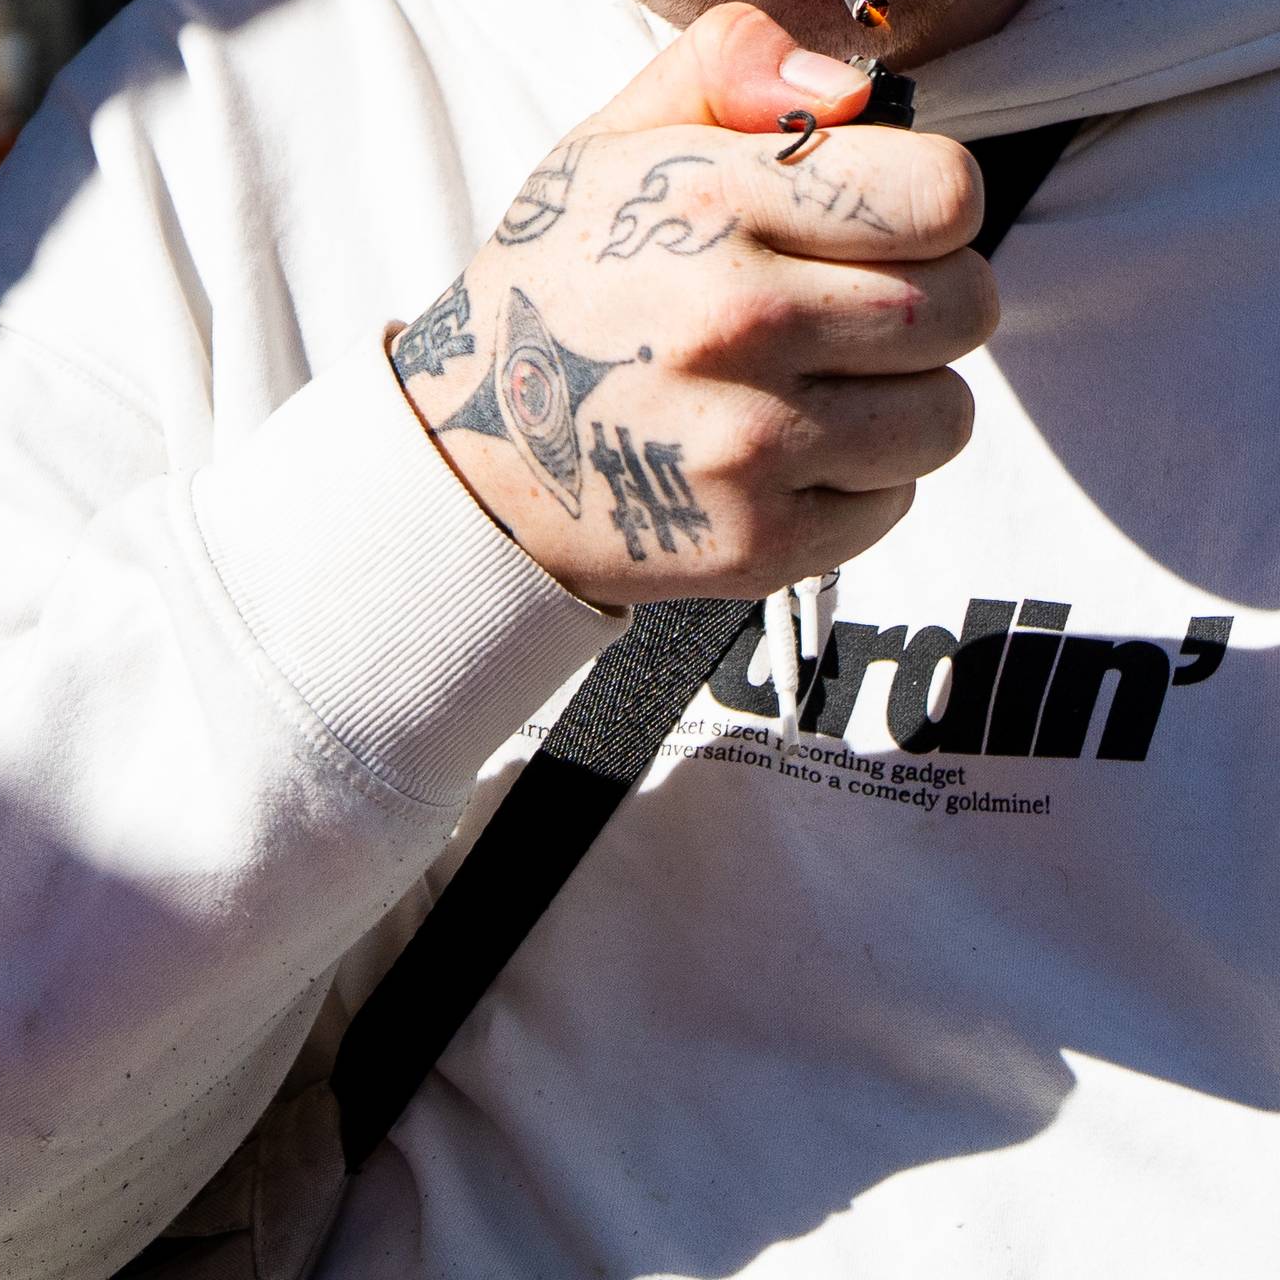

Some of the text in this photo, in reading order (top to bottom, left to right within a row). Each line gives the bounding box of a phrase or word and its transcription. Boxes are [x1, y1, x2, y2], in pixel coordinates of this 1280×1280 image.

[705, 598, 1235, 762] ordin'
[660, 743, 1051, 816] nversation into a comedy goldmine!
[676, 719, 704, 735] ket
[711, 719, 769, 746] sized
[776, 739, 886, 781] rcording
[890, 762, 966, 790] gadget
